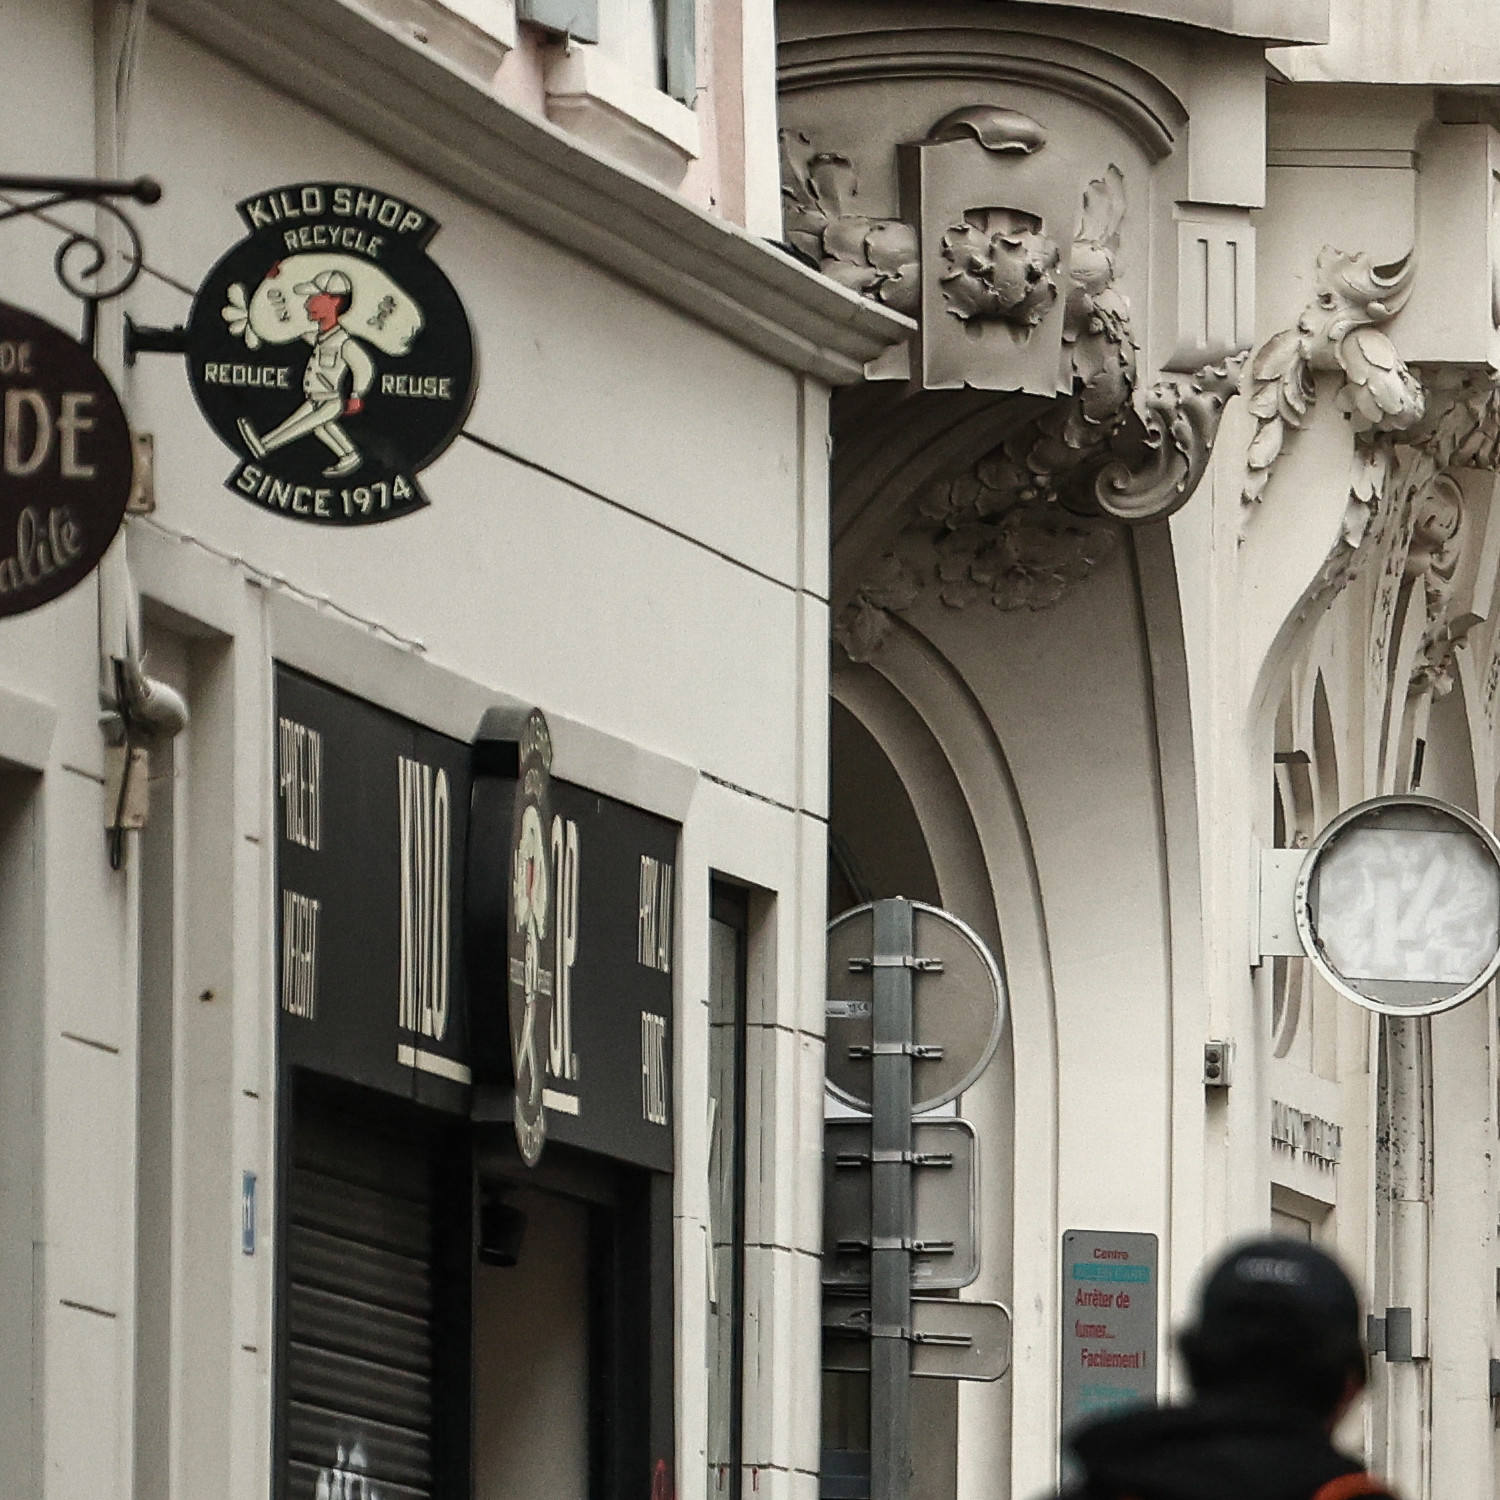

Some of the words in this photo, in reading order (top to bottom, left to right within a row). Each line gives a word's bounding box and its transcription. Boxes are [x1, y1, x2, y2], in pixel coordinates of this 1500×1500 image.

[247, 187, 322, 229] KILO
[333, 188, 422, 232] SHOP
[283, 225, 384, 257] RECYCLE
[204, 362, 289, 388] REDUCE
[381, 373, 451, 399] REUSE
[237, 464, 330, 518] SINCE
[340, 473, 412, 517] 1974
[1093, 1248, 1130, 1260] Centre
[1116, 1290, 1131, 1309] de
[1081, 1347, 1140, 1369] Facilement
